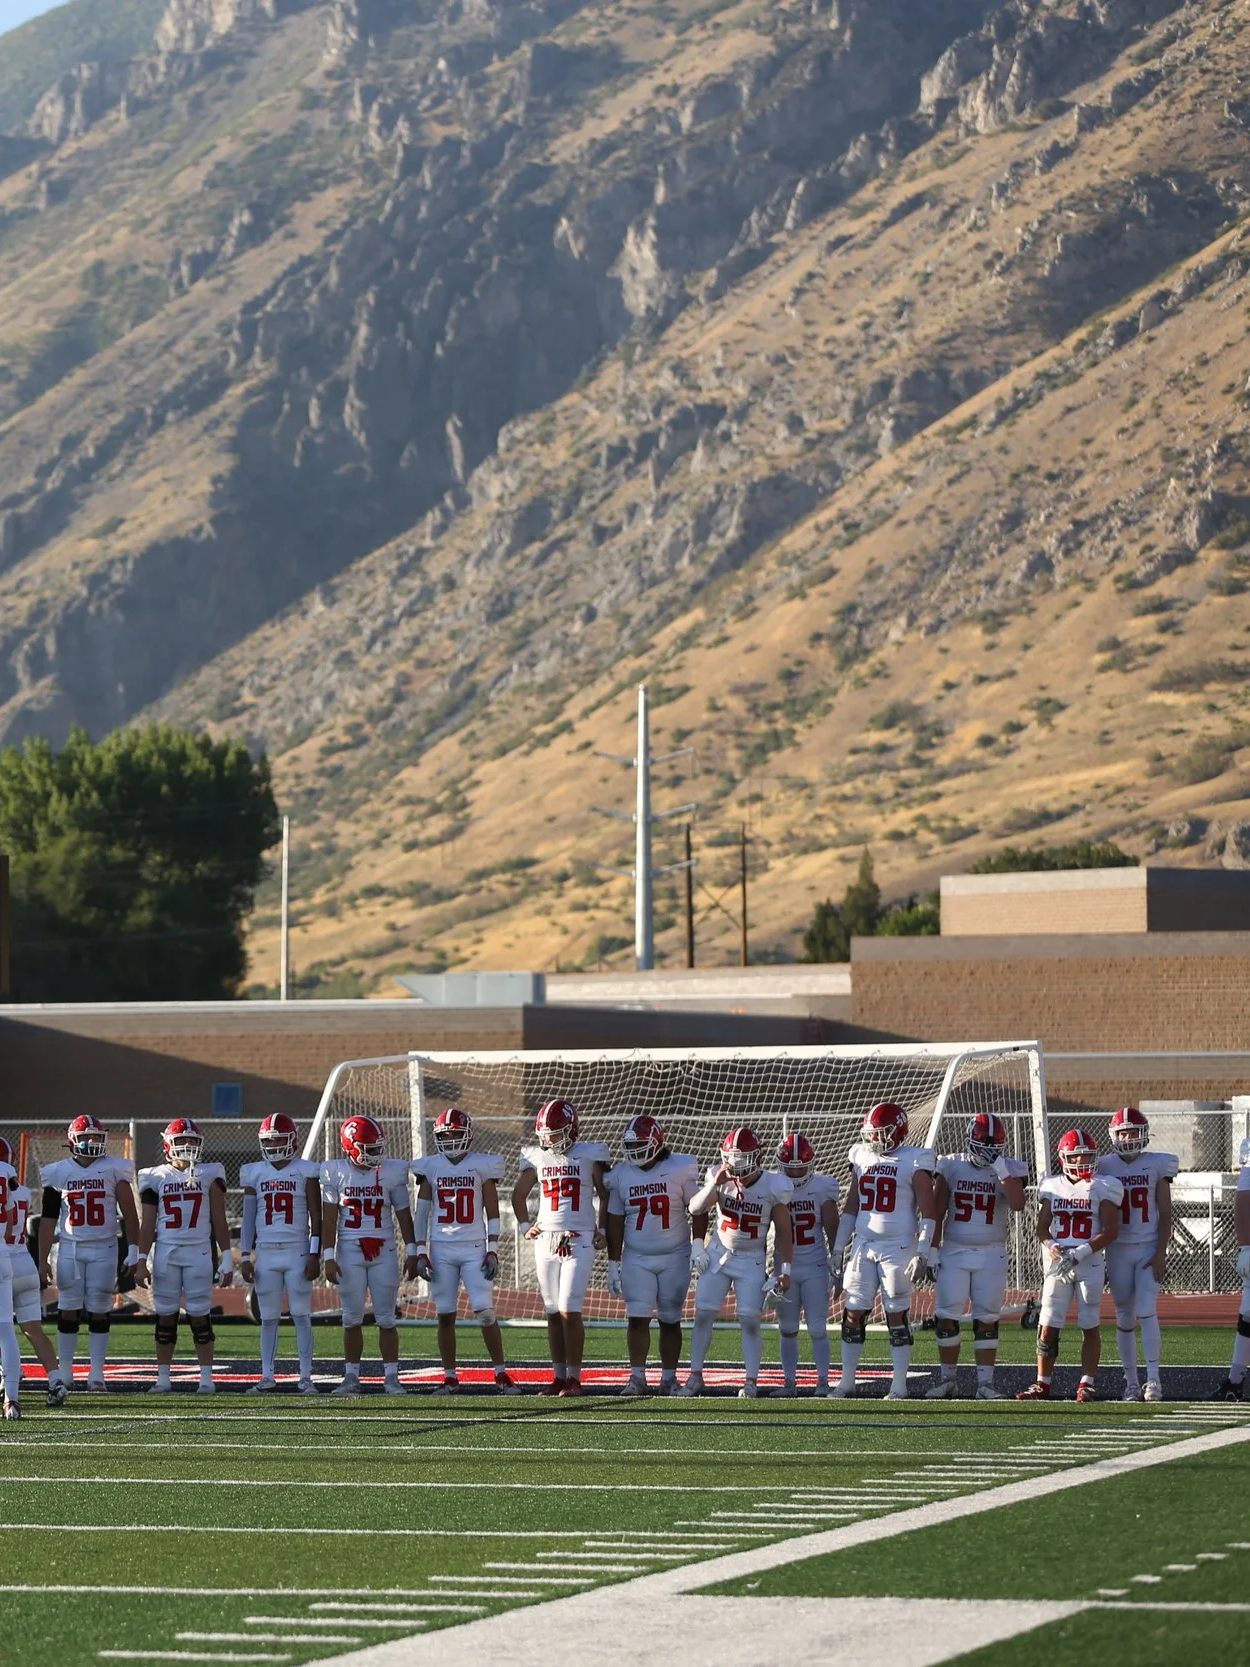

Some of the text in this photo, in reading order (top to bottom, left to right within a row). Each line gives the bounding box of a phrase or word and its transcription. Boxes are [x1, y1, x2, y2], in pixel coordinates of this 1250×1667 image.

[437, 1177, 475, 1187] CRIMSON
[542, 1165, 580, 1177] CRIMSON
[67, 1179, 104, 1191] CRIMSON
[261, 1181, 296, 1192] CRIMSON
[541, 1178, 581, 1212] 49
[629, 1182, 667, 1197] CRIMSON
[859, 1175, 897, 1213] 58
[957, 1180, 996, 1194] CRIMSON
[162, 1193, 203, 1229] 57
[264, 1192, 293, 1225] 19
[343, 1198, 385, 1229] 34
[437, 1188, 475, 1225] 50
[629, 1194, 670, 1231] 79
[724, 1198, 763, 1215] CRIMSON
[790, 1200, 815, 1212] MSON
[953, 1192, 996, 1225] 54
[1053, 1198, 1092, 1210] CRIMSON
[1053, 1211, 1093, 1239] 36
